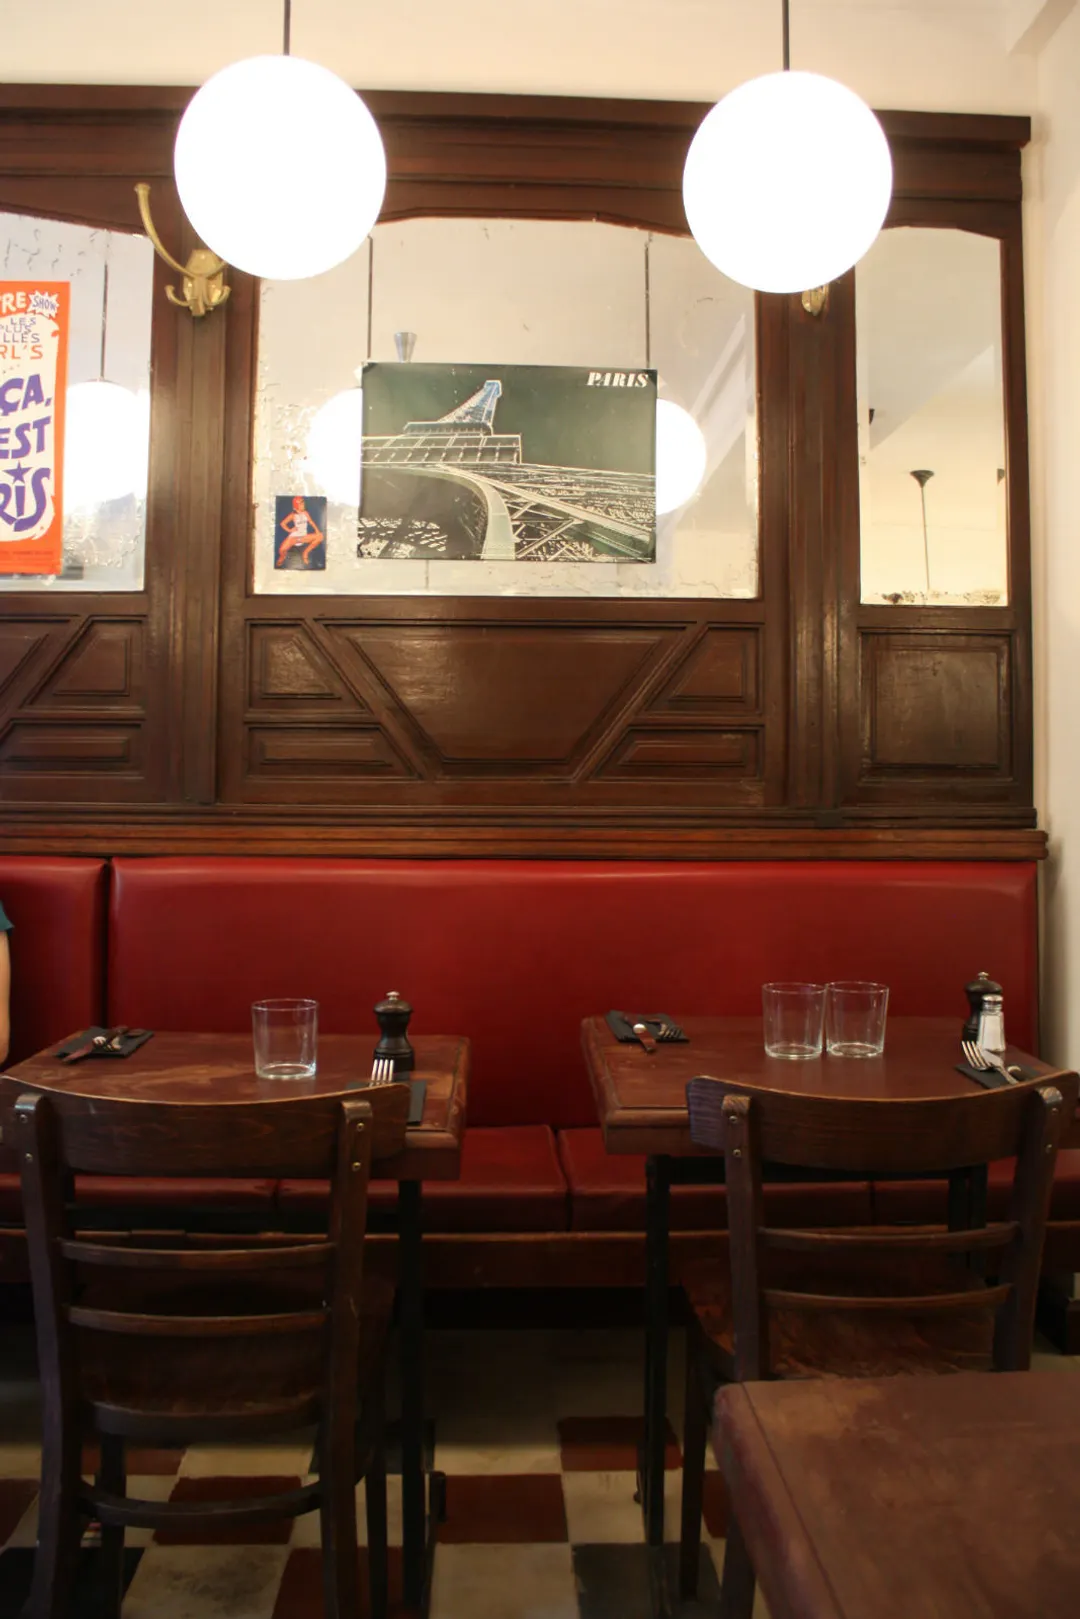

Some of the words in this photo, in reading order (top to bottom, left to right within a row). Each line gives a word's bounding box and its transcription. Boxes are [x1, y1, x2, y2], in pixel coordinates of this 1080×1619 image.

[32, 295, 56, 311] SHOW
[10, 317, 37, 326] LES
[3, 333, 40, 343] LLES
[586, 371, 649, 388] PARIS
